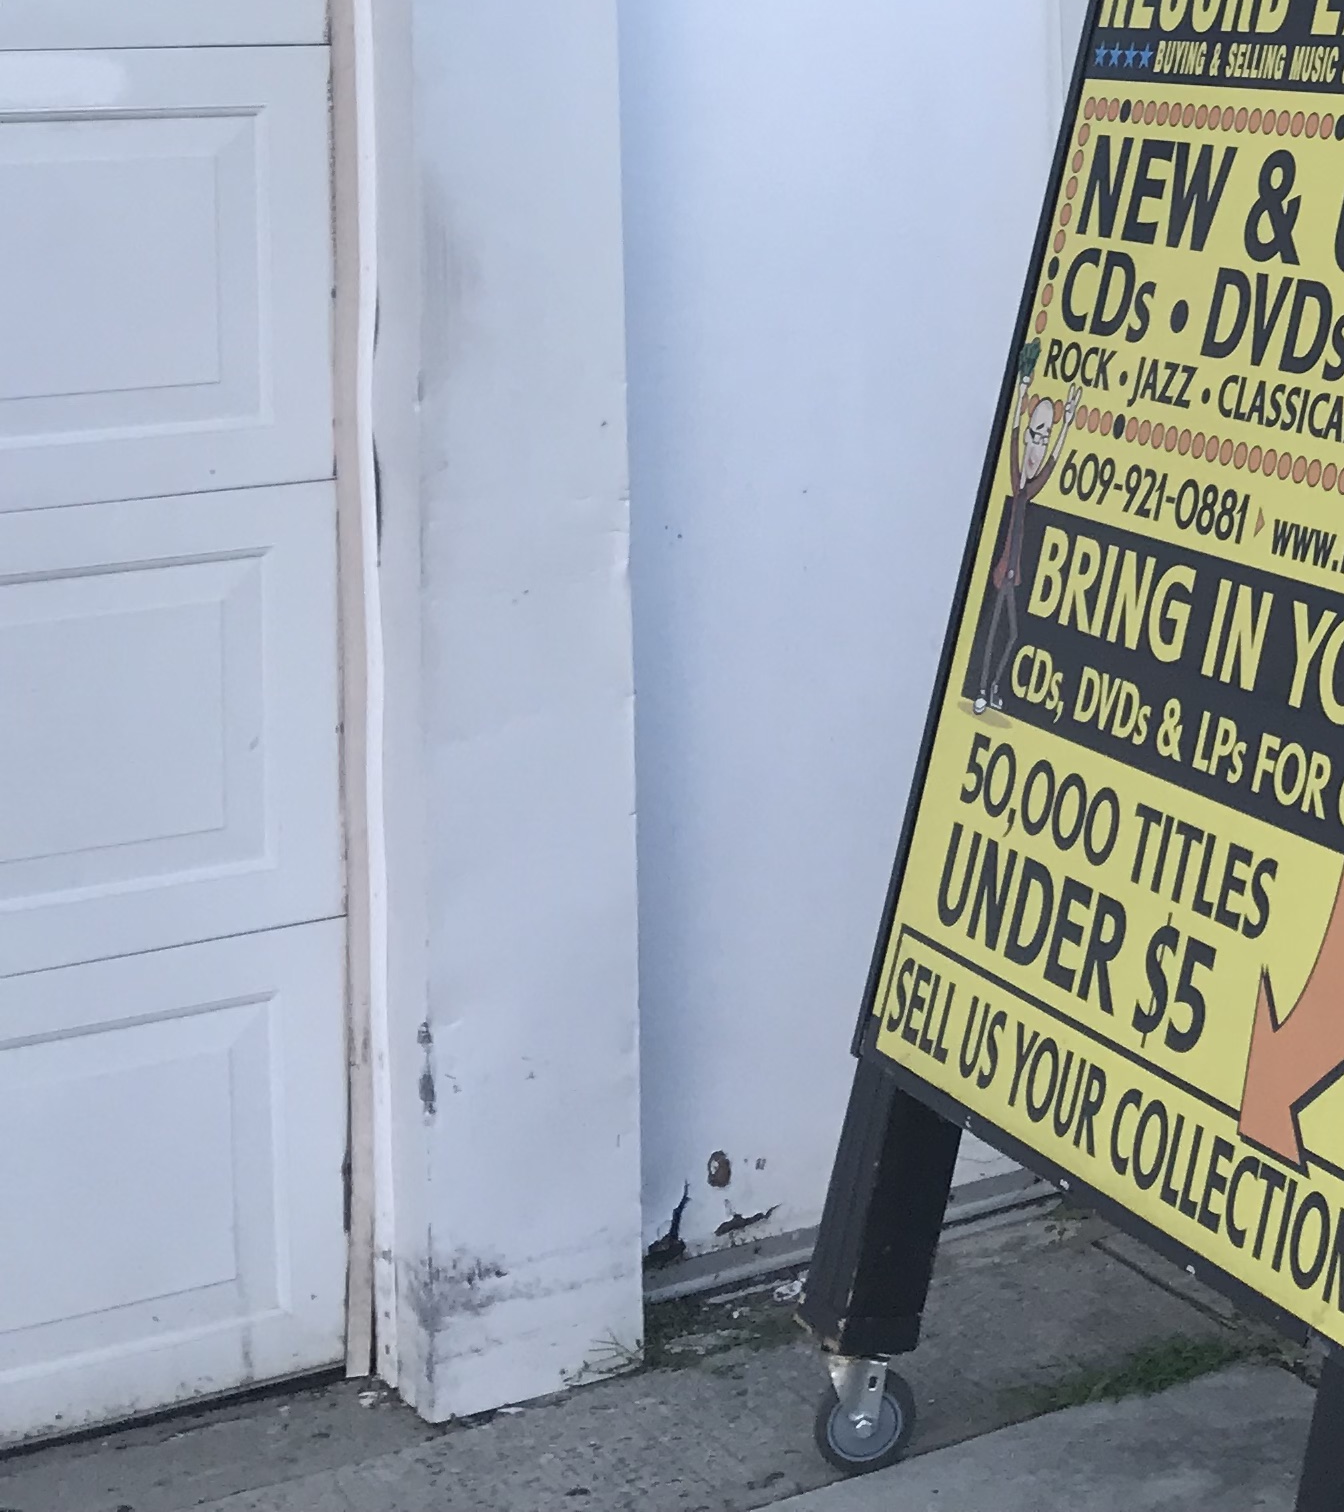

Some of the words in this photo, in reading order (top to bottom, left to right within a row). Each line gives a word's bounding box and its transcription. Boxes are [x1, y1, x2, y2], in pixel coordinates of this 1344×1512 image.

[1153, 40, 1207, 74] BUYING
[1209, 47, 1222, 76] &
[1225, 44, 1287, 81] SELLING
[1290, 47, 1338, 83] MUSIC
[1076, 134, 1237, 251] NEW
[1243, 149, 1303, 266] &
[1061, 246, 1157, 343] CDs
[1043, 338, 1116, 391] ROCK
[1127, 357, 1197, 409] JAZZ
[1059, 449, 1251, 544] 609-921-0881
[1027, 524, 1198, 663] BRING
[1200, 579, 1273, 694] IN
[1010, 644, 1063, 721] CDs,
[1074, 666, 1148, 747] DVDs
[1156, 698, 1182, 761] &
[1192, 711, 1246, 784] LPs
[1253, 733, 1332, 822] FOR
[960, 734, 1120, 868] 50,000
[1130, 802, 1279, 940] TITLES
[937, 822, 1129, 1016] UNDER
[1131, 911, 1217, 1053] $5
[886, 957, 949, 1064] SELL
[959, 995, 1008, 1091] US
[1008, 1021, 1107, 1157] YOUR
